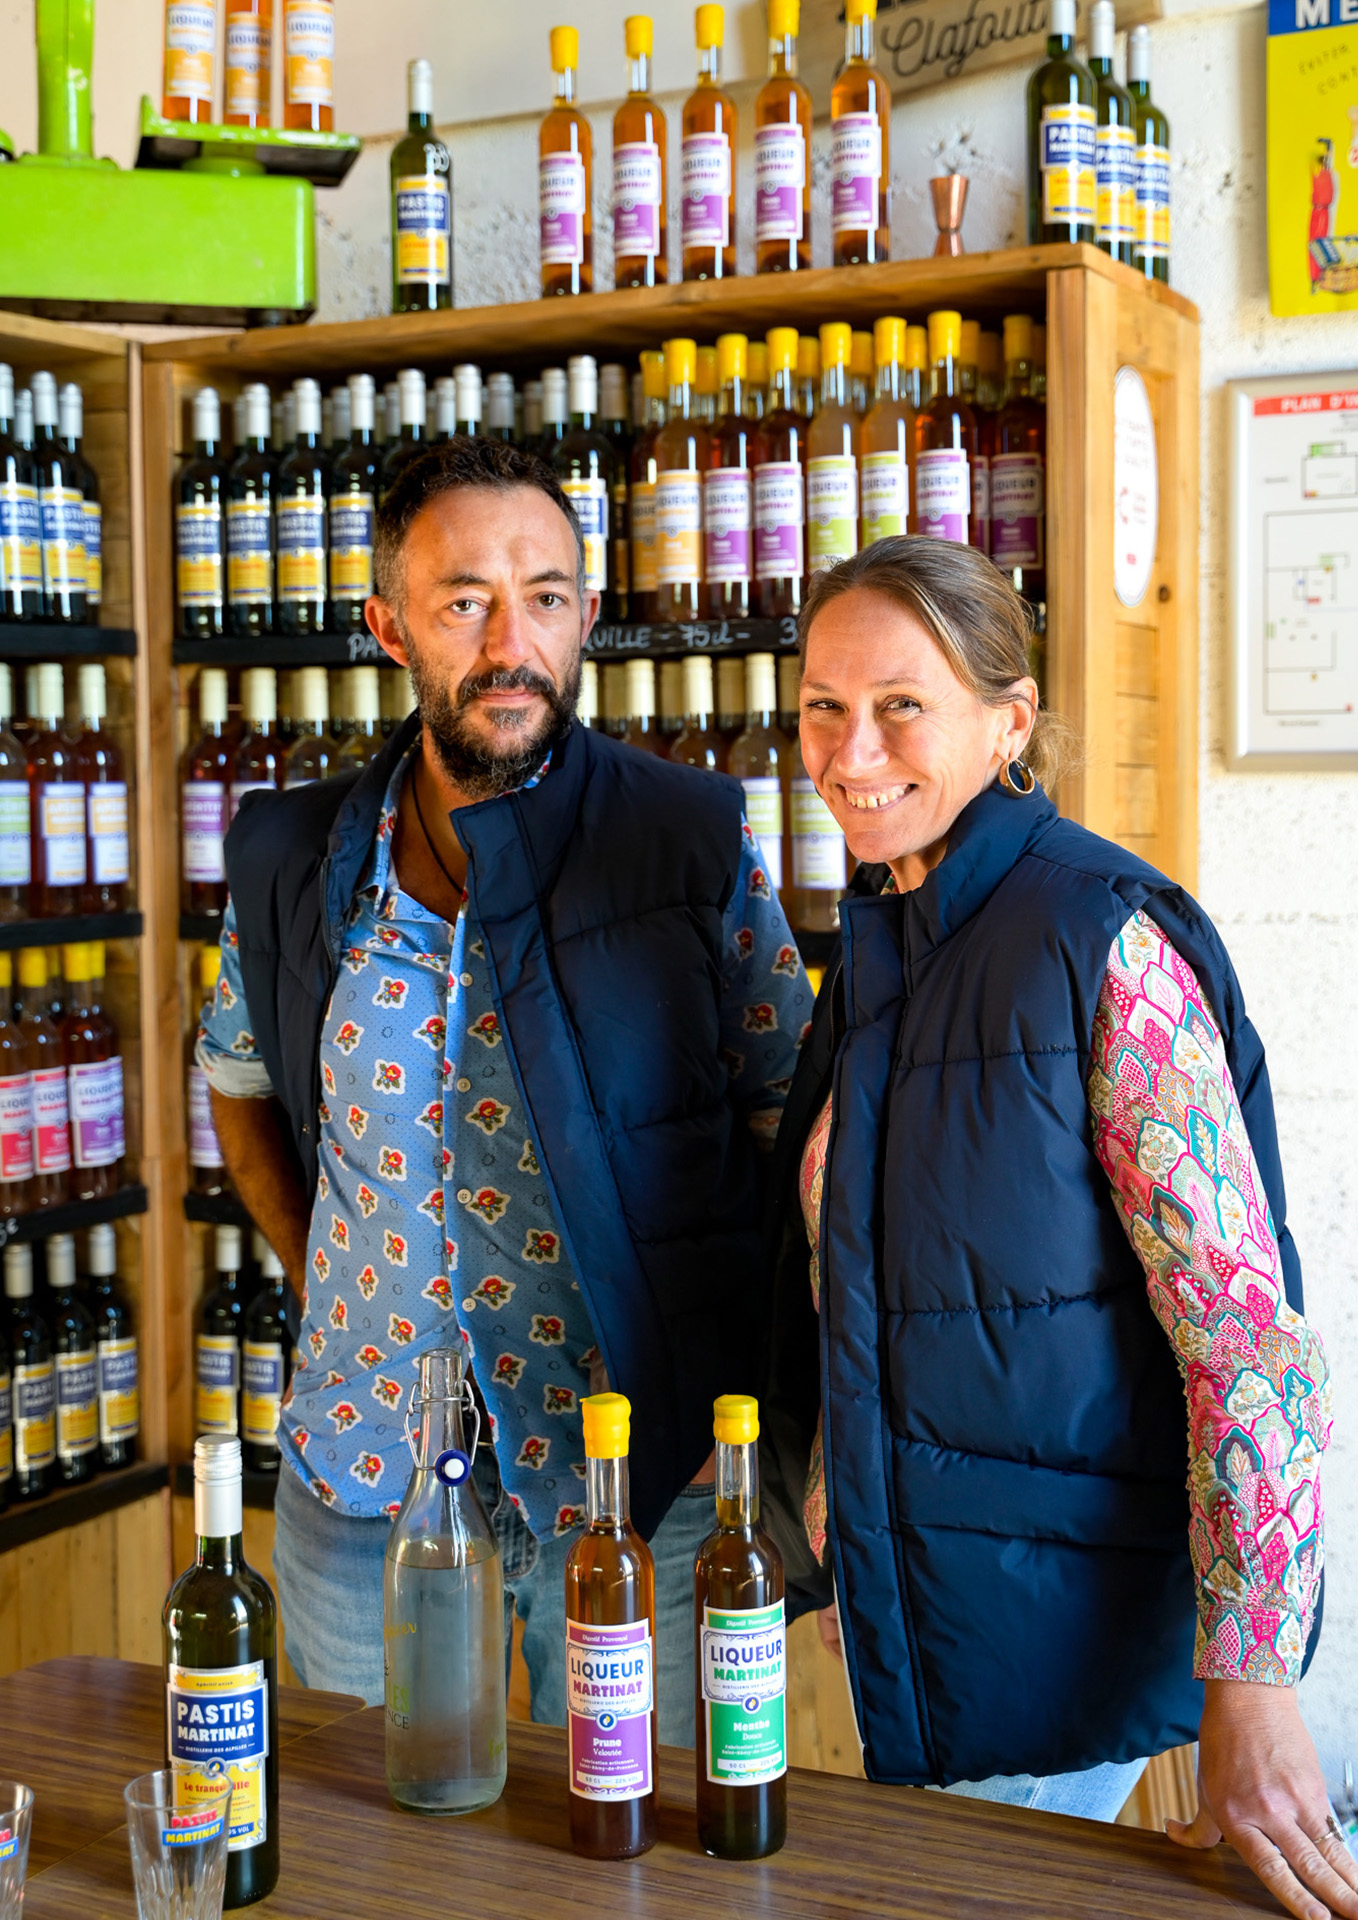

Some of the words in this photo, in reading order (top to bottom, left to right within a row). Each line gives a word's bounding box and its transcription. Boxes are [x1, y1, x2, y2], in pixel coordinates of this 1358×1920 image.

[881, 0, 1050, 78] Clafouti
[1281, 396, 1322, 413] PLAN
[710, 1638, 783, 1666] LIQUEUR
[571, 1657, 645, 1681] LIQUEUR
[713, 1660, 782, 1681] MARTINAT
[573, 1680, 643, 1698] MARTINAT
[177, 1699, 255, 1725] PASTIS
[177, 1722, 255, 1742] MARTINAT
[733, 1719, 770, 1732] Menthe
[185, 1745, 213, 1753] DISTILLERIE
[225, 1743, 247, 1752] ALPILLES
[592, 1737, 622, 1747] Prune
[593, 1747, 623, 1757] Veloutée
[581, 1757, 608, 1766] Fabrication
[184, 1781, 194, 1792] Le
[171, 1808, 217, 1829] PASTIS
[165, 1822, 221, 1844] MARTINAT
[238, 1825, 250, 1834] VOL
